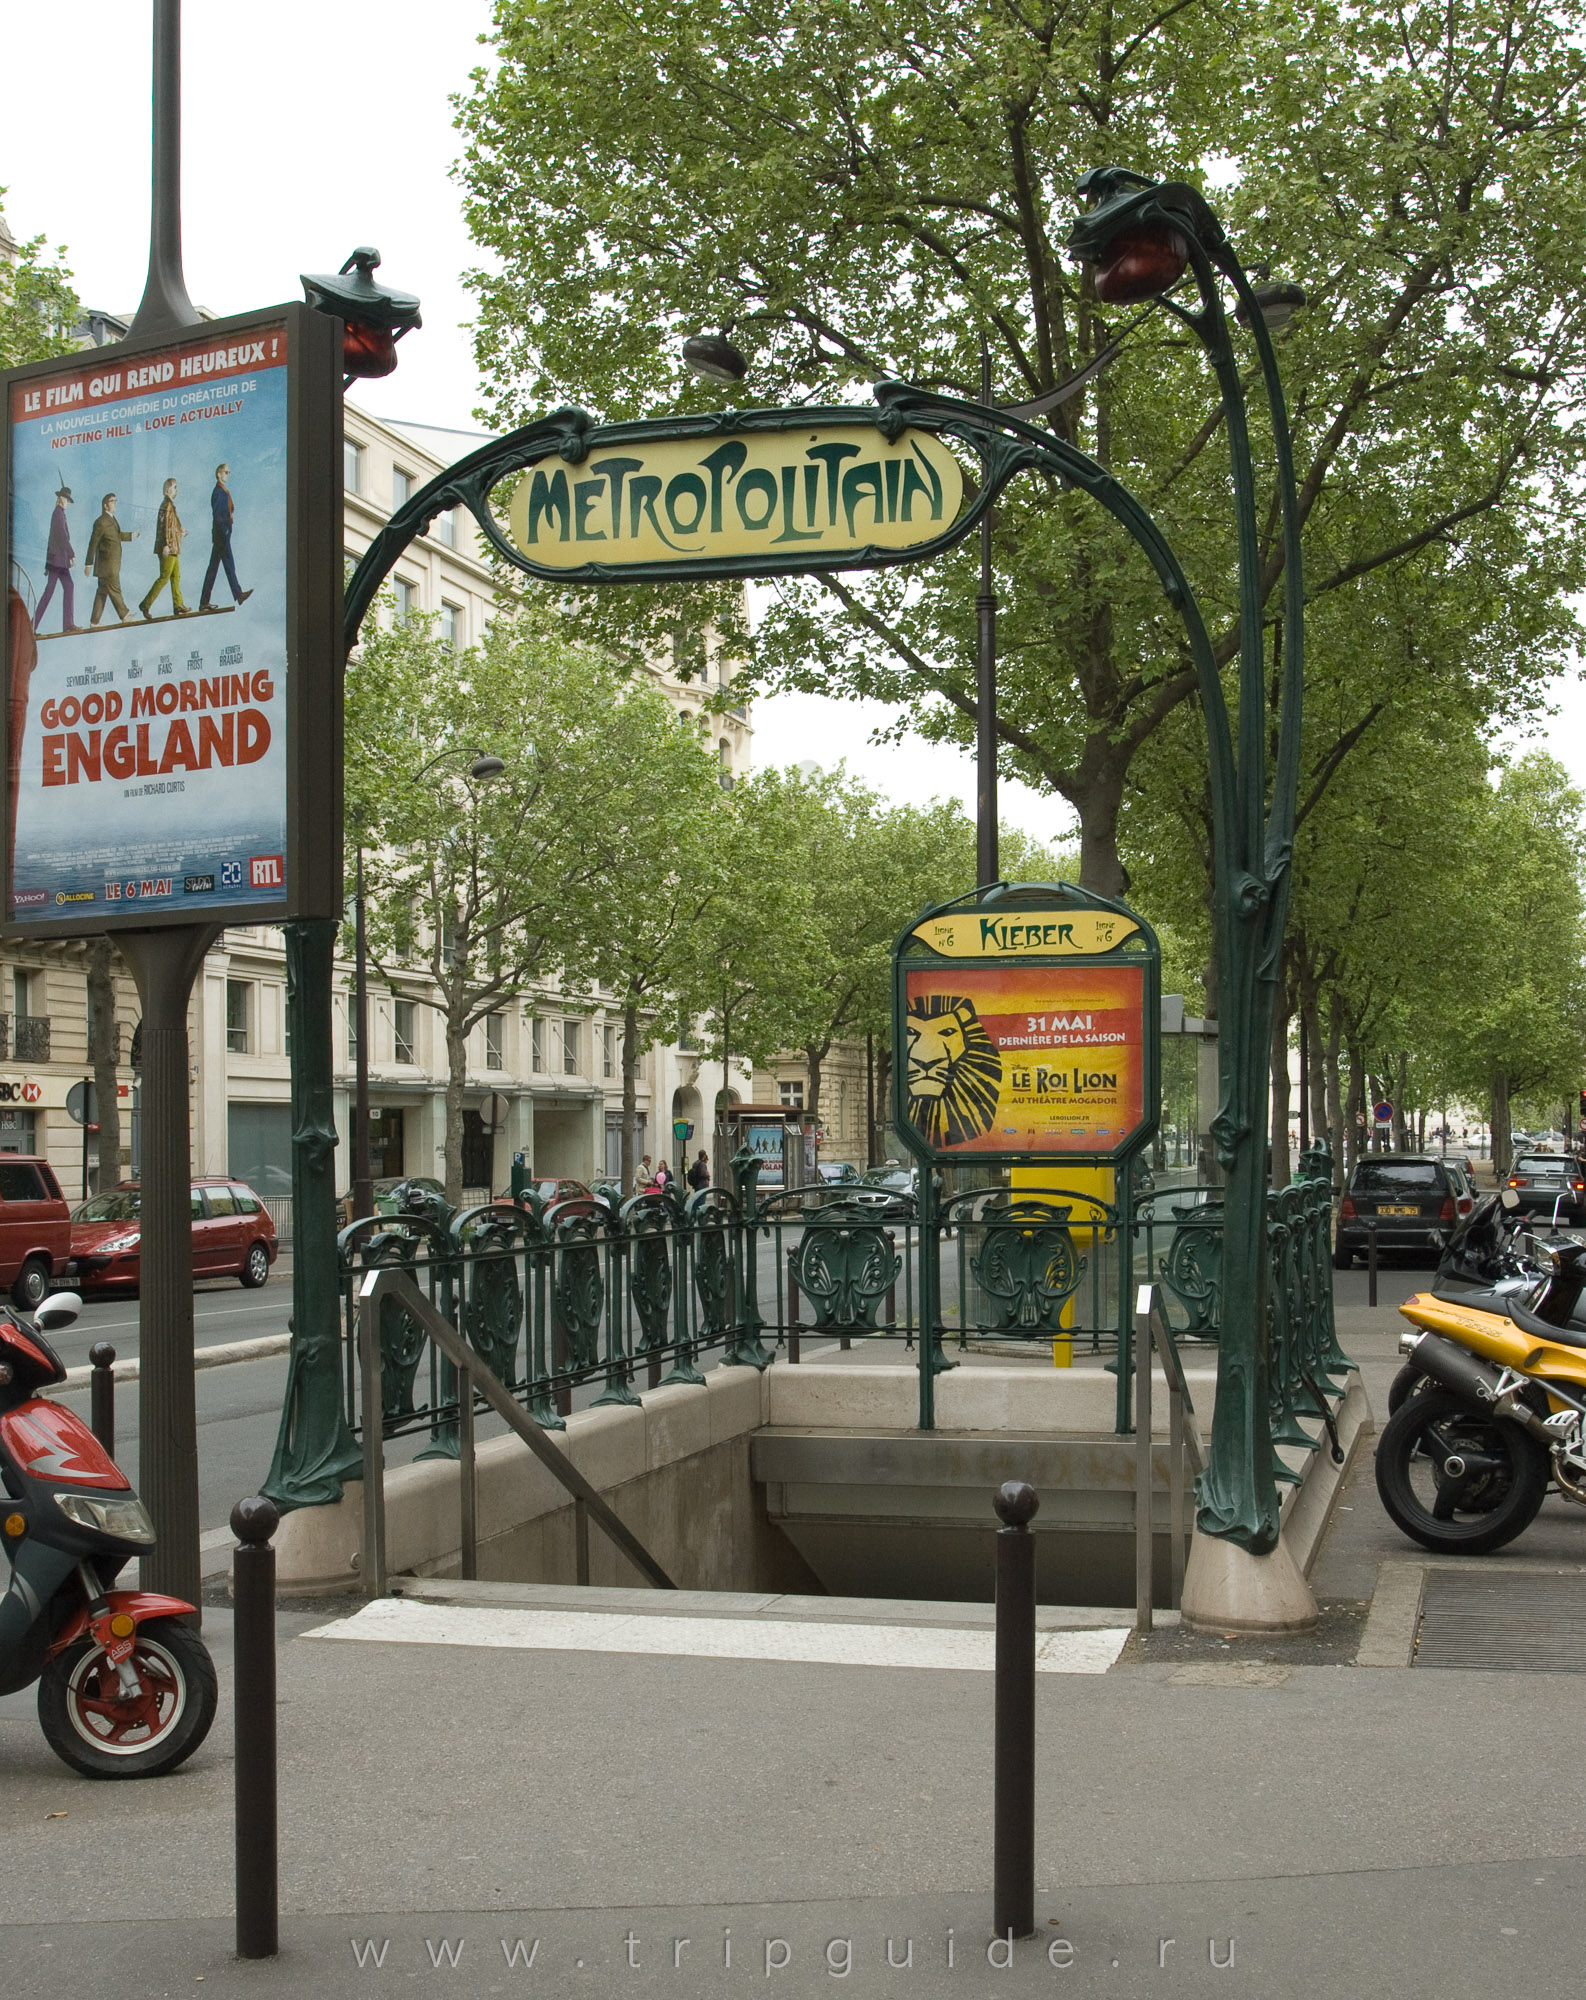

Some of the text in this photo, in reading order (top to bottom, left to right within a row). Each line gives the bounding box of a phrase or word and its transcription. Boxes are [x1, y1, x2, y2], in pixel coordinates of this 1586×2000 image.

[24, 338, 278, 413] LE FILM QUI REND HEUREUX !
[40, 423, 54, 435] LA
[56, 411, 109, 433] NOUVELLE
[163, 397, 177, 410] DU
[180, 383, 238, 406] CRÉATEUR
[241, 380, 257, 393] DE
[51, 400, 244, 450] NOTTING HILL & LOVE ACTUALLY
[527, 438, 944, 552] METROPOLITAIN
[187, 658, 203, 671] FROST
[219, 652, 244, 667] BRANAGH
[127, 667, 143, 680] NIGHY
[157, 663, 173, 676] IFANS
[66, 671, 114, 688] SEYMOUR HOFFMAN
[40, 669, 274, 730] GOOD MORNING
[41, 708, 272, 787] ENGLAND
[143, 783, 166, 796] RICHARD
[167, 780, 185, 794] CURTIS
[221, 862, 242, 884] 20
[252, 859, 281, 885] RTL
[105, 883, 121, 900] LE
[125, 881, 136, 898] 6
[139, 878, 173, 898] MAI
[14, 893, 45, 904] YAHOO!
[1027, 1017, 1046, 1032] 31
[999, 1032, 1126, 1046] DERNIÈRE DE LA SAISON
[1012, 1073, 1031, 1088] LE
[1069, 1097, 1117, 1105] MOGADOR
[1, 1121, 17, 1130] HSBC
[112, 1640, 131, 1658] ABS
